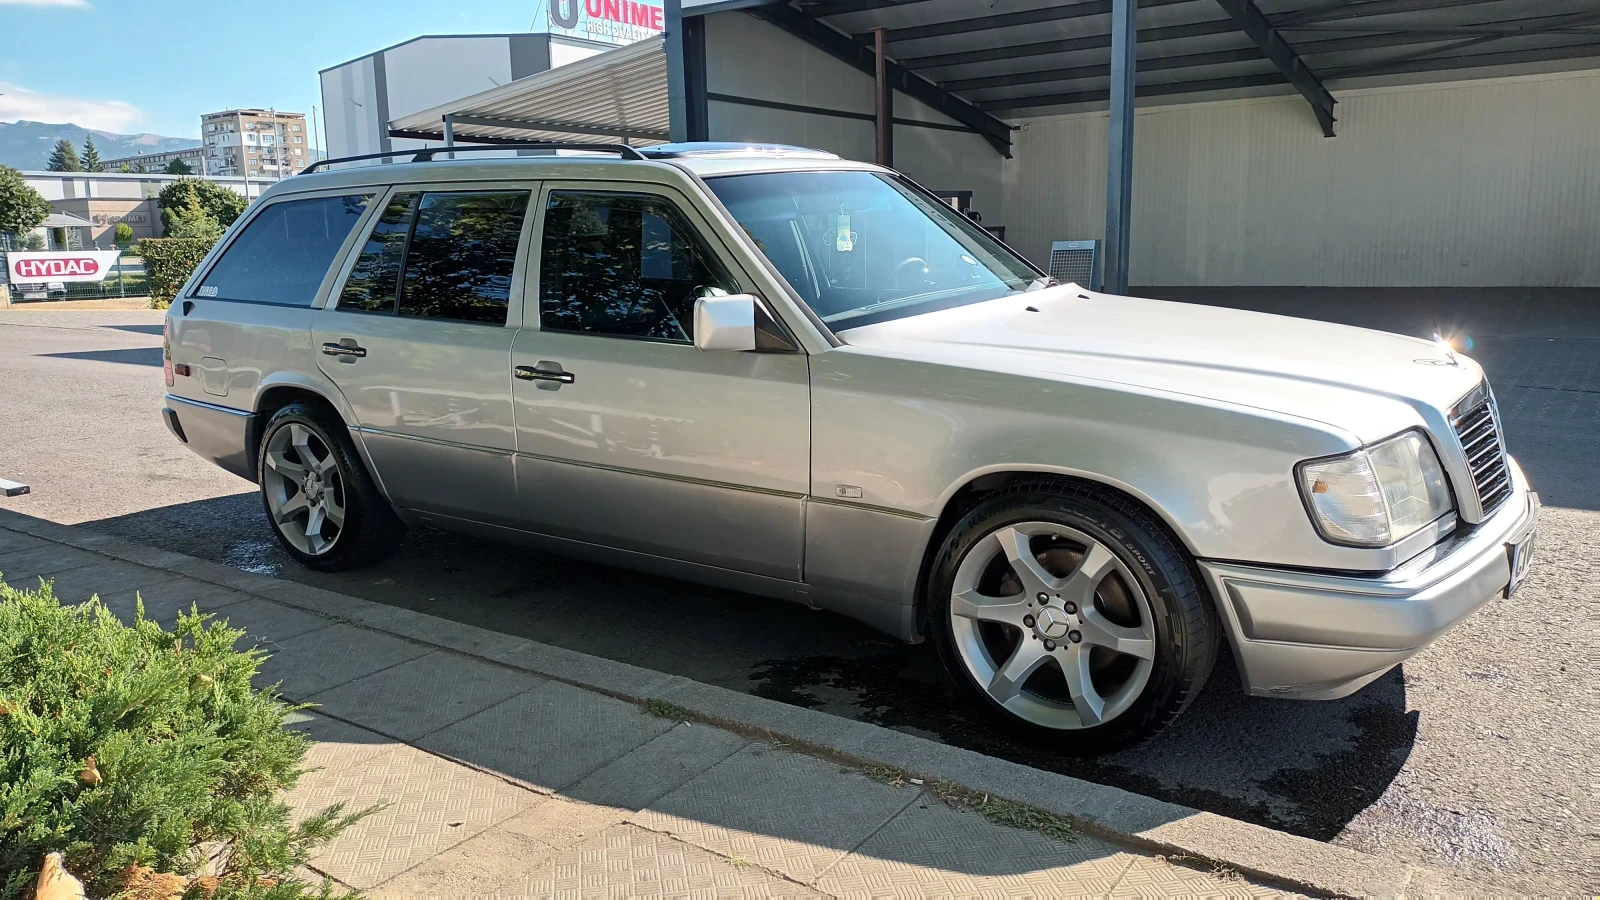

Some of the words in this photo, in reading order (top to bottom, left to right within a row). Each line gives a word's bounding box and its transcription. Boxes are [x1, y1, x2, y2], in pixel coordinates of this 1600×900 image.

[585, 0, 664, 31] UNIME
[586, 20, 611, 36] HIGH
[111, 215, 146, 224] UNIMET
[20, 259, 95, 276] HYDAC
[1125, 543, 1156, 576] SPORT
